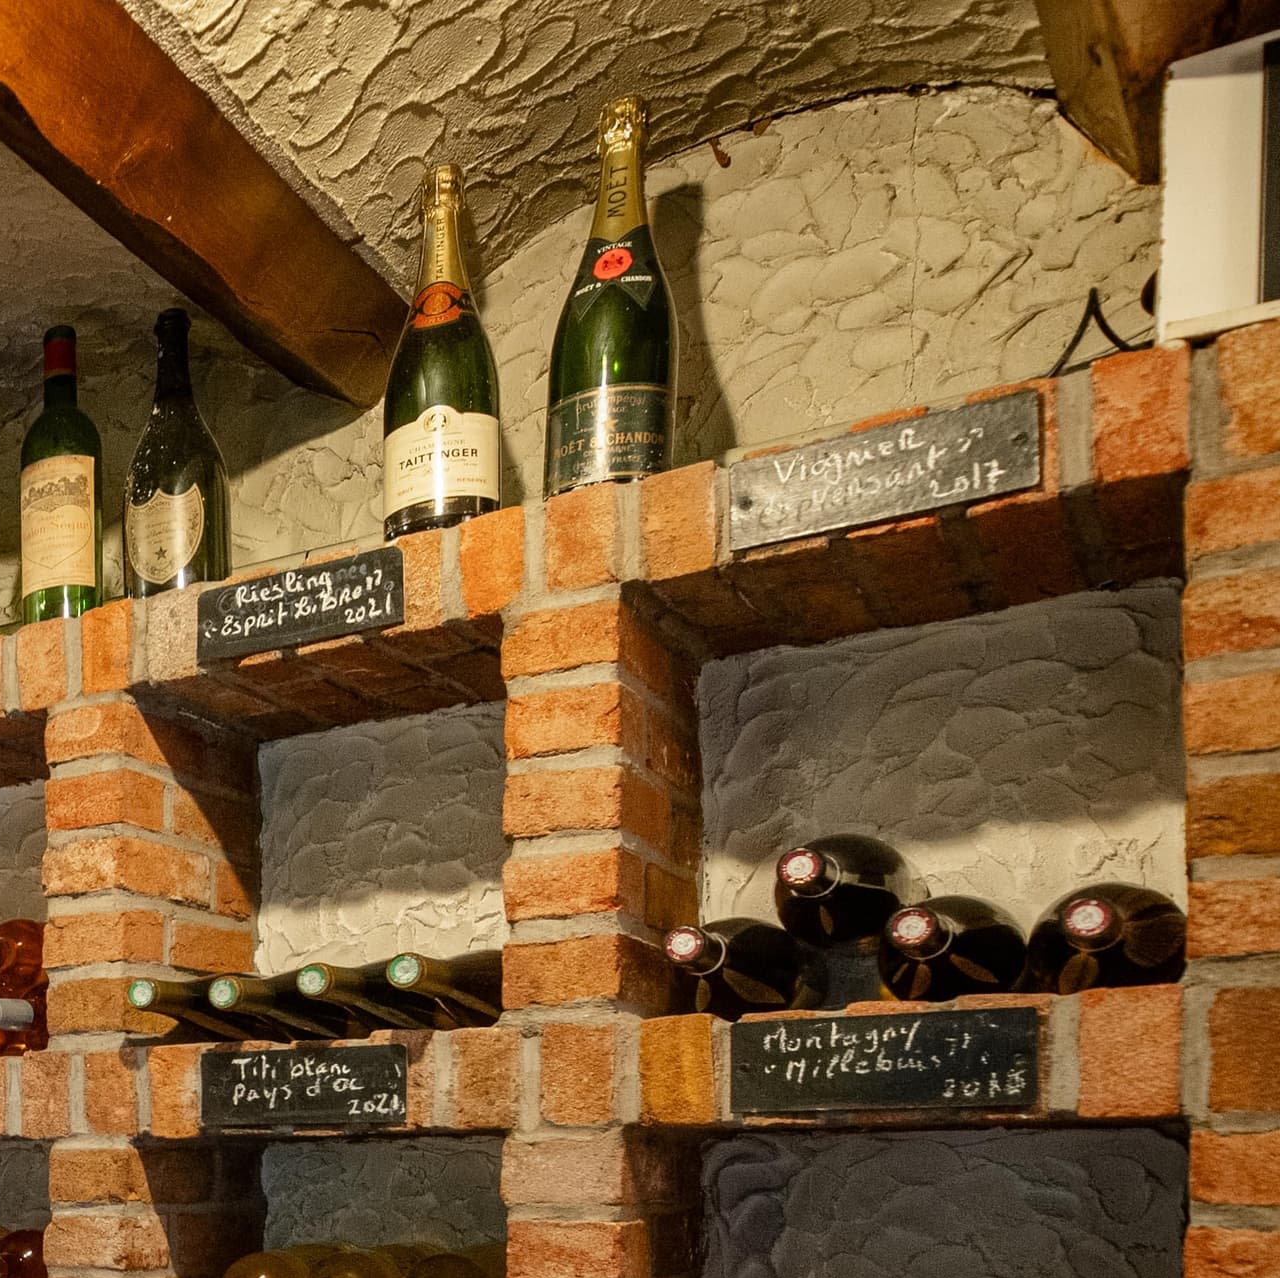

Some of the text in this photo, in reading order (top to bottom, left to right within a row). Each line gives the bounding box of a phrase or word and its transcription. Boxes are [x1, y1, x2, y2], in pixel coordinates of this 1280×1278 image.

[399, 447, 479, 471] TAITTNGER
[235, 571, 333, 608] Riesling
[344, 592, 392, 625] 2021
[762, 1020, 921, 1053] Montagny
[231, 1054, 277, 1080] Titi
[232, 1082, 292, 1109] Pays
